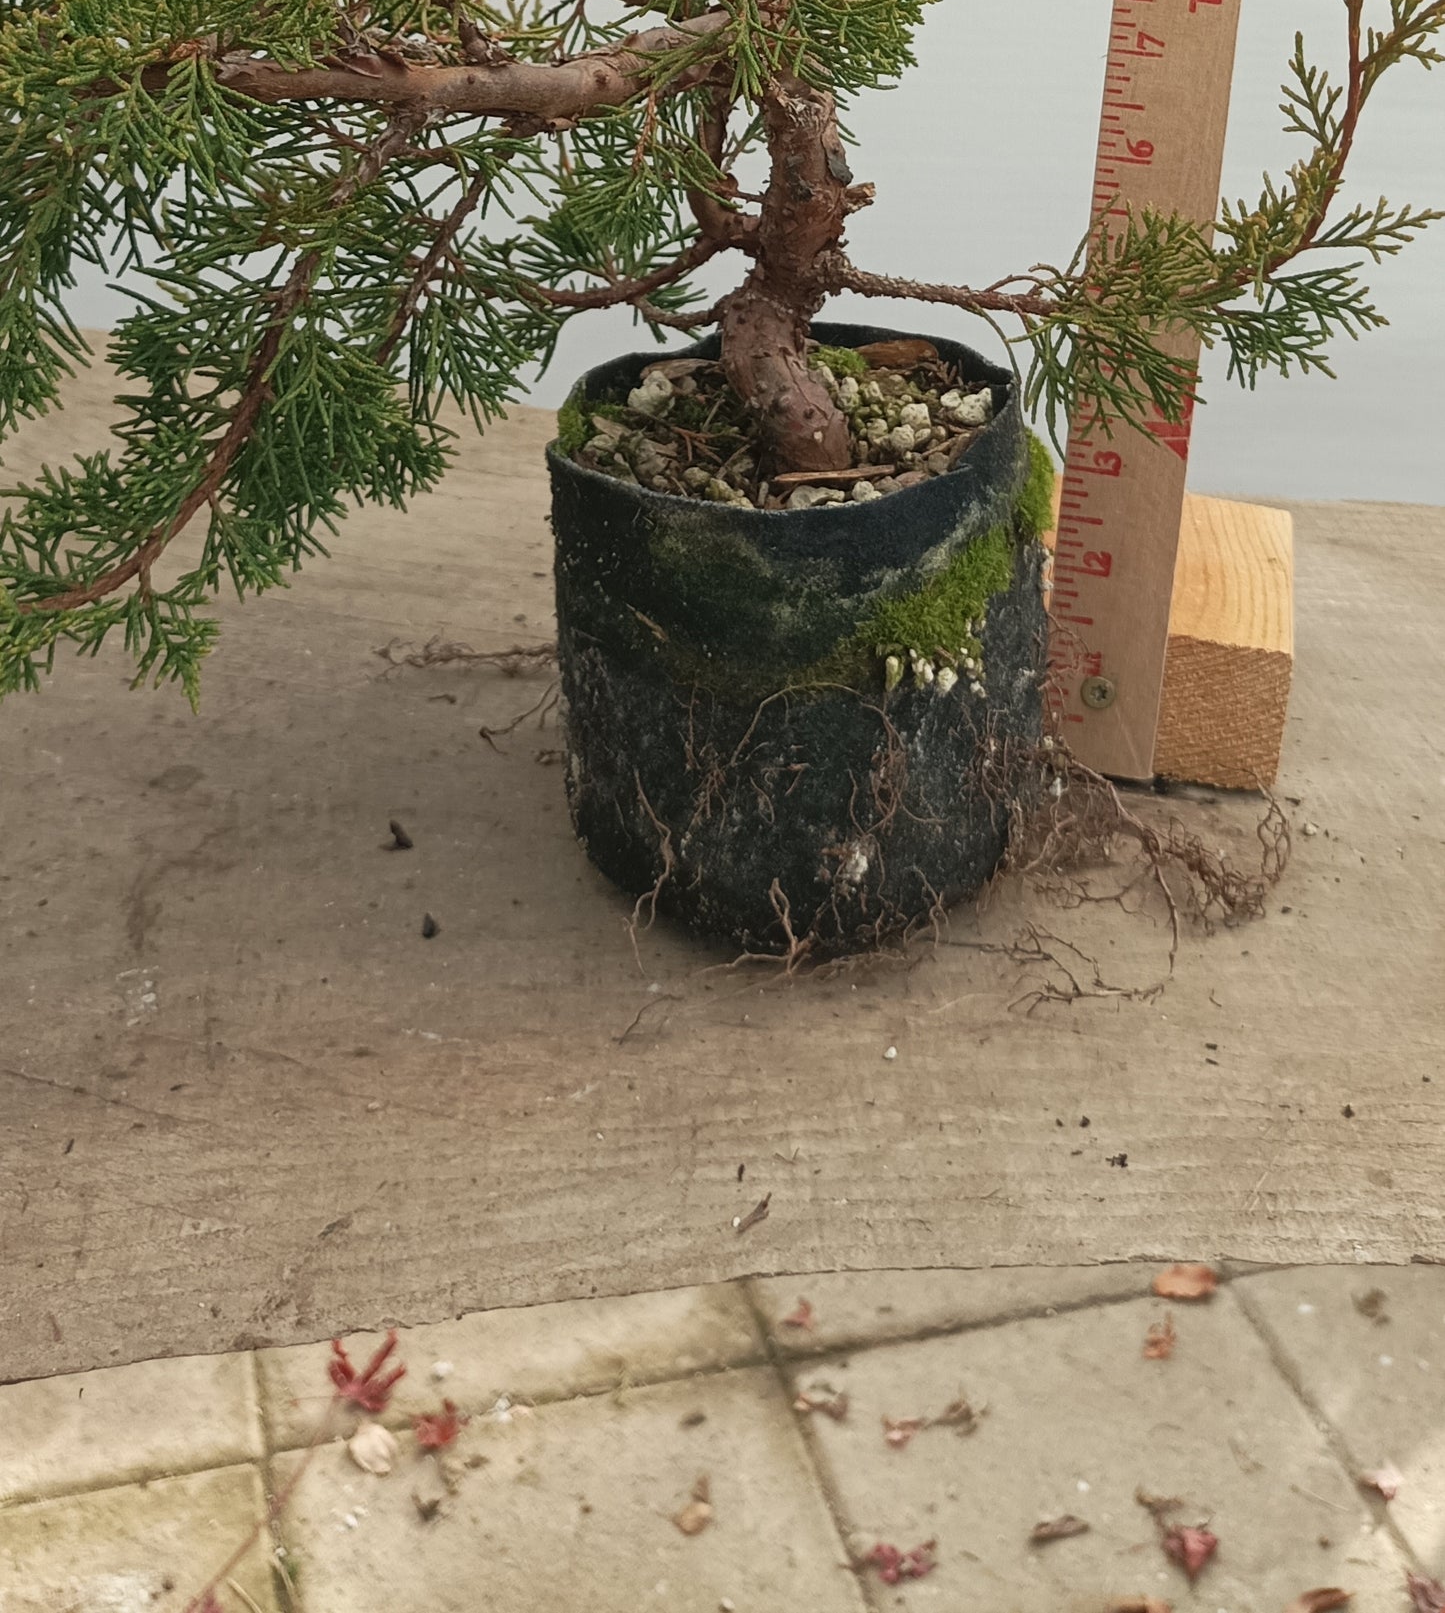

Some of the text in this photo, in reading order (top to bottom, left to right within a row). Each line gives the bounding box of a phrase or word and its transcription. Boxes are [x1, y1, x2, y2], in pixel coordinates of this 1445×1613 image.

[1136, 30, 1166, 50] 7
[1126, 138, 1155, 159] 6
[1093, 450, 1122, 475] 3
[1083, 551, 1112, 576] 2
